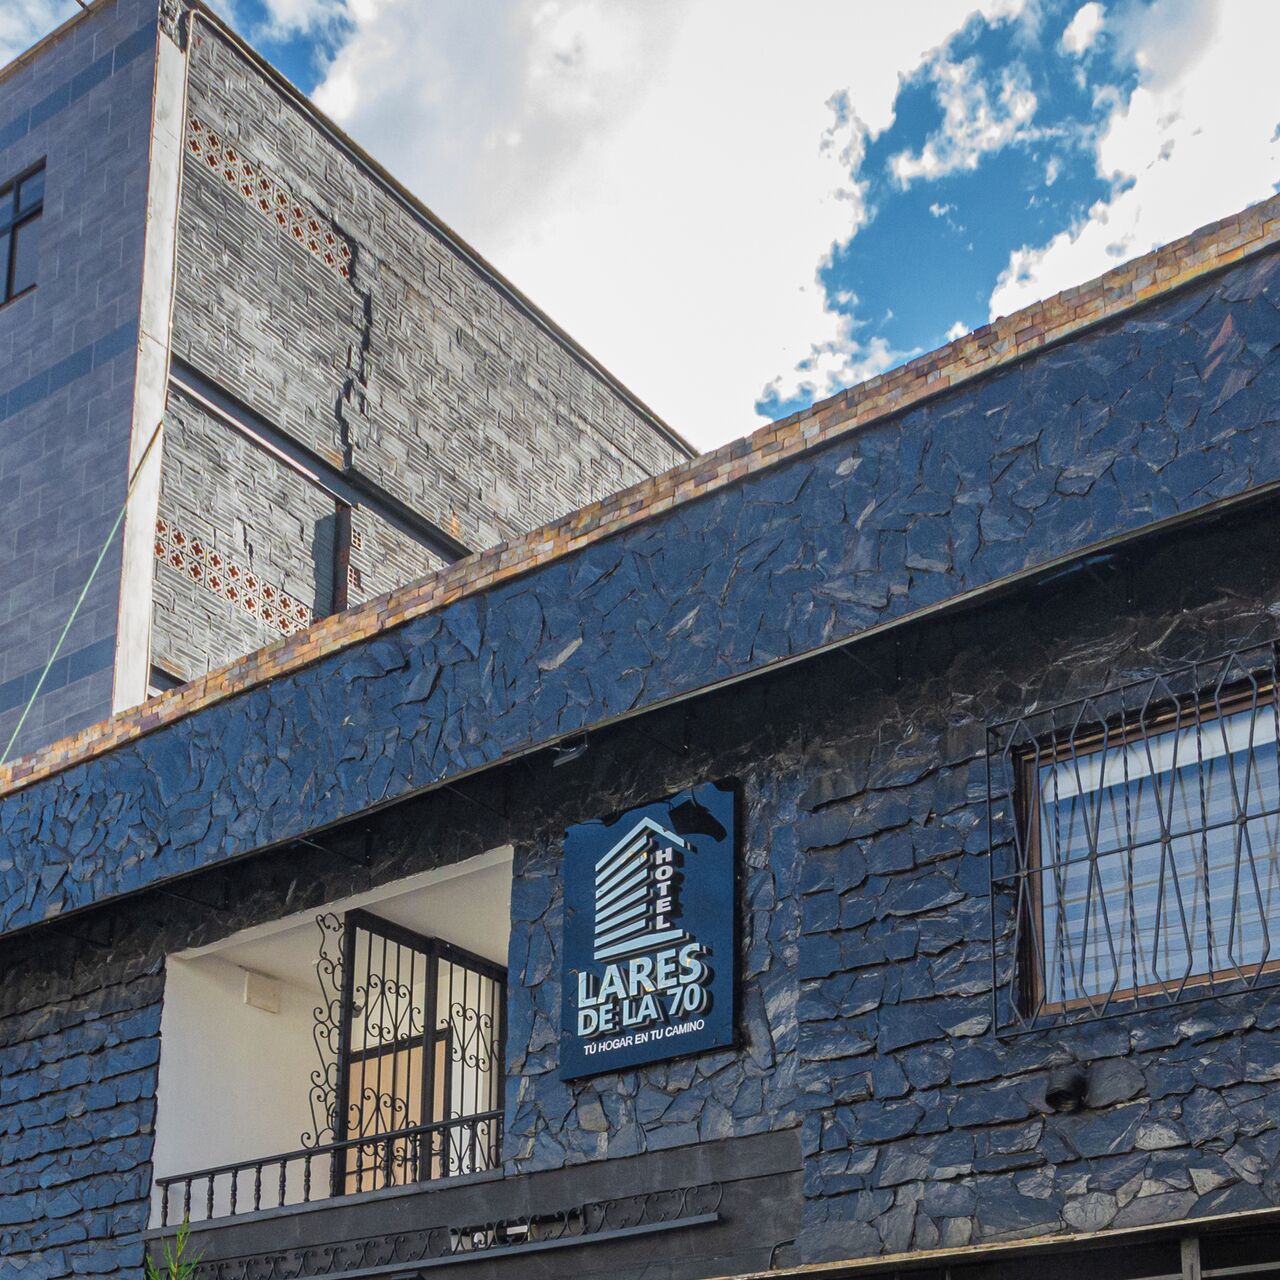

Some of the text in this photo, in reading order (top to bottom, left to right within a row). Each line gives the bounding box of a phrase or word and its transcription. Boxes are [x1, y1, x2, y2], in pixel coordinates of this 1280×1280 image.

[655, 847, 673, 930] HOTEL
[578, 942, 702, 1008] LARES
[577, 983, 701, 1037] DE LA 70
[583, 1019, 705, 1056] TÚ HOGAR EN TU CAMINO
